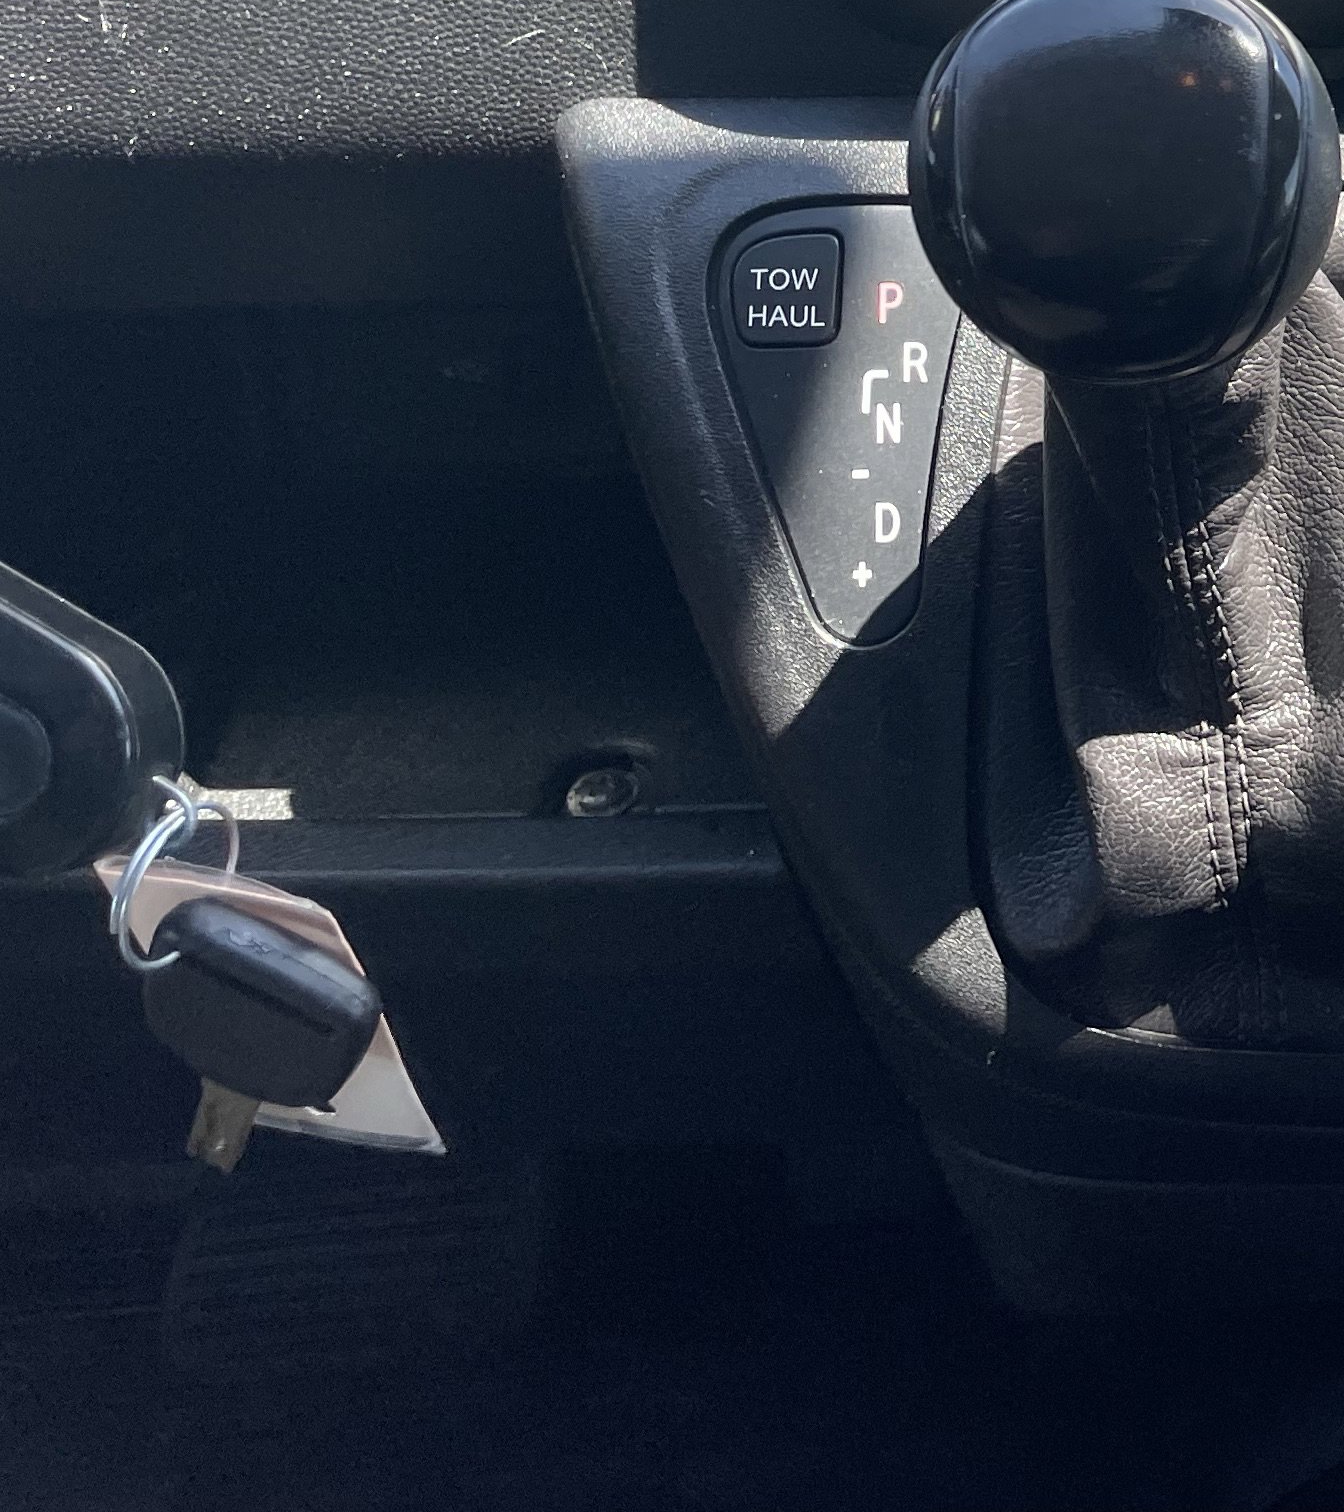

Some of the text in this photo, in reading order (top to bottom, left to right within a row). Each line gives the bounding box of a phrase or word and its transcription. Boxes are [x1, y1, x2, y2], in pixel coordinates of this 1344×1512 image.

[751, 268, 818, 290] TOW
[749, 305, 825, 327] HAUL
[877, 281, 903, 324] P
[902, 342, 928, 382] R
[875, 403, 901, 444] N
[875, 502, 900, 543] D
